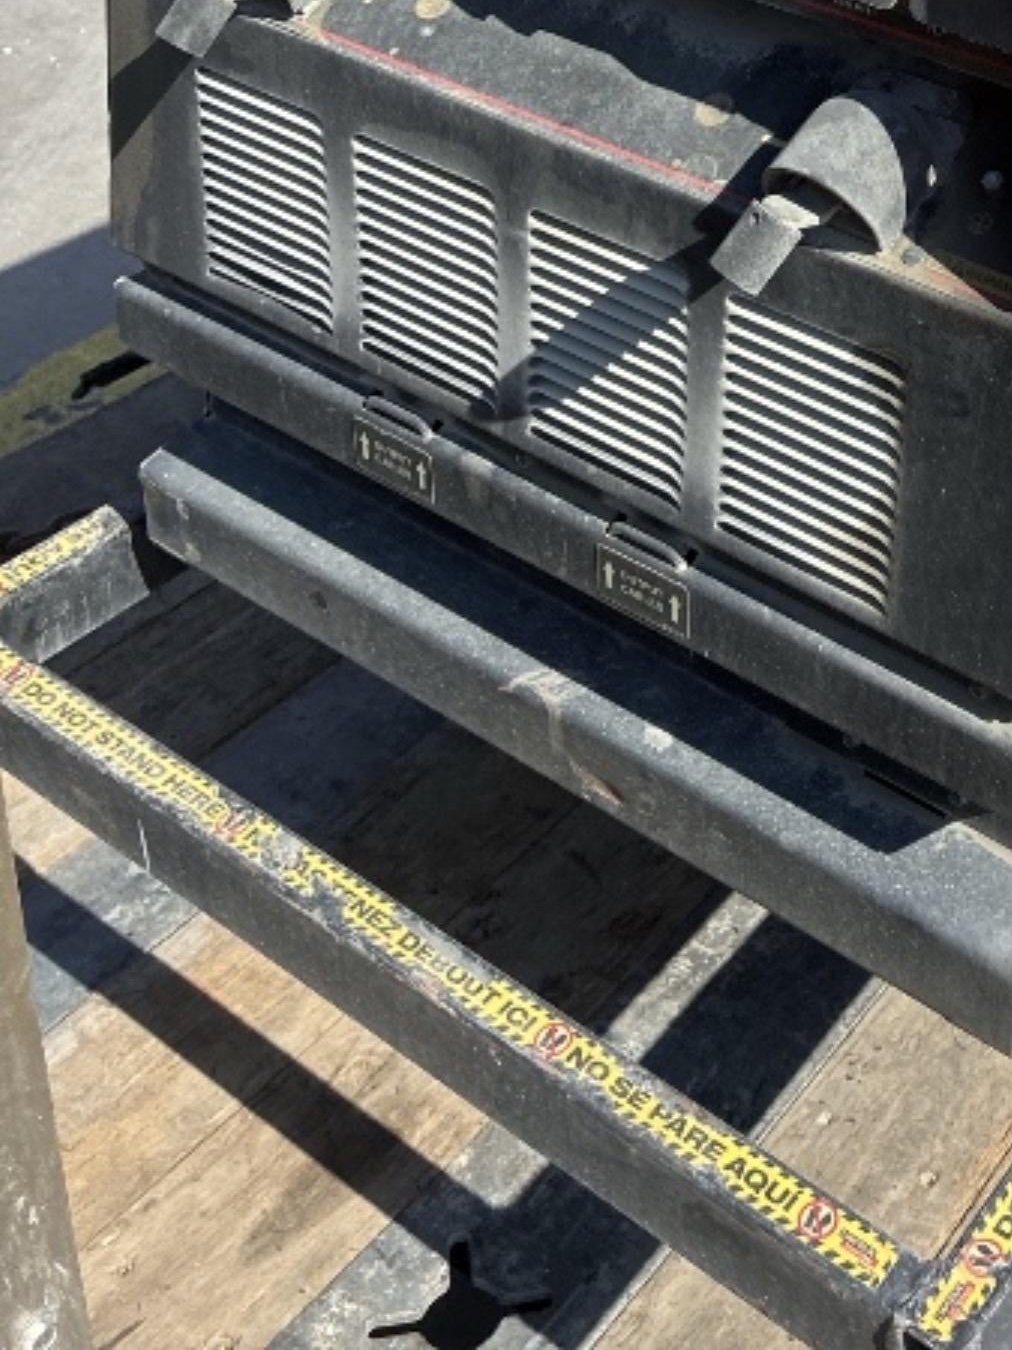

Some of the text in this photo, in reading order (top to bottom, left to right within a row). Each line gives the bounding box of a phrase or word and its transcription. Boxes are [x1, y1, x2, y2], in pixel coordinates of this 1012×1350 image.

[24, 682, 228, 818] DO NOT STAND HERE
[502, 996, 538, 1032] ICI
[567, 1045, 611, 1083] NO
[612, 1076, 652, 1109] SE
[652, 1103, 727, 1163] PARE
